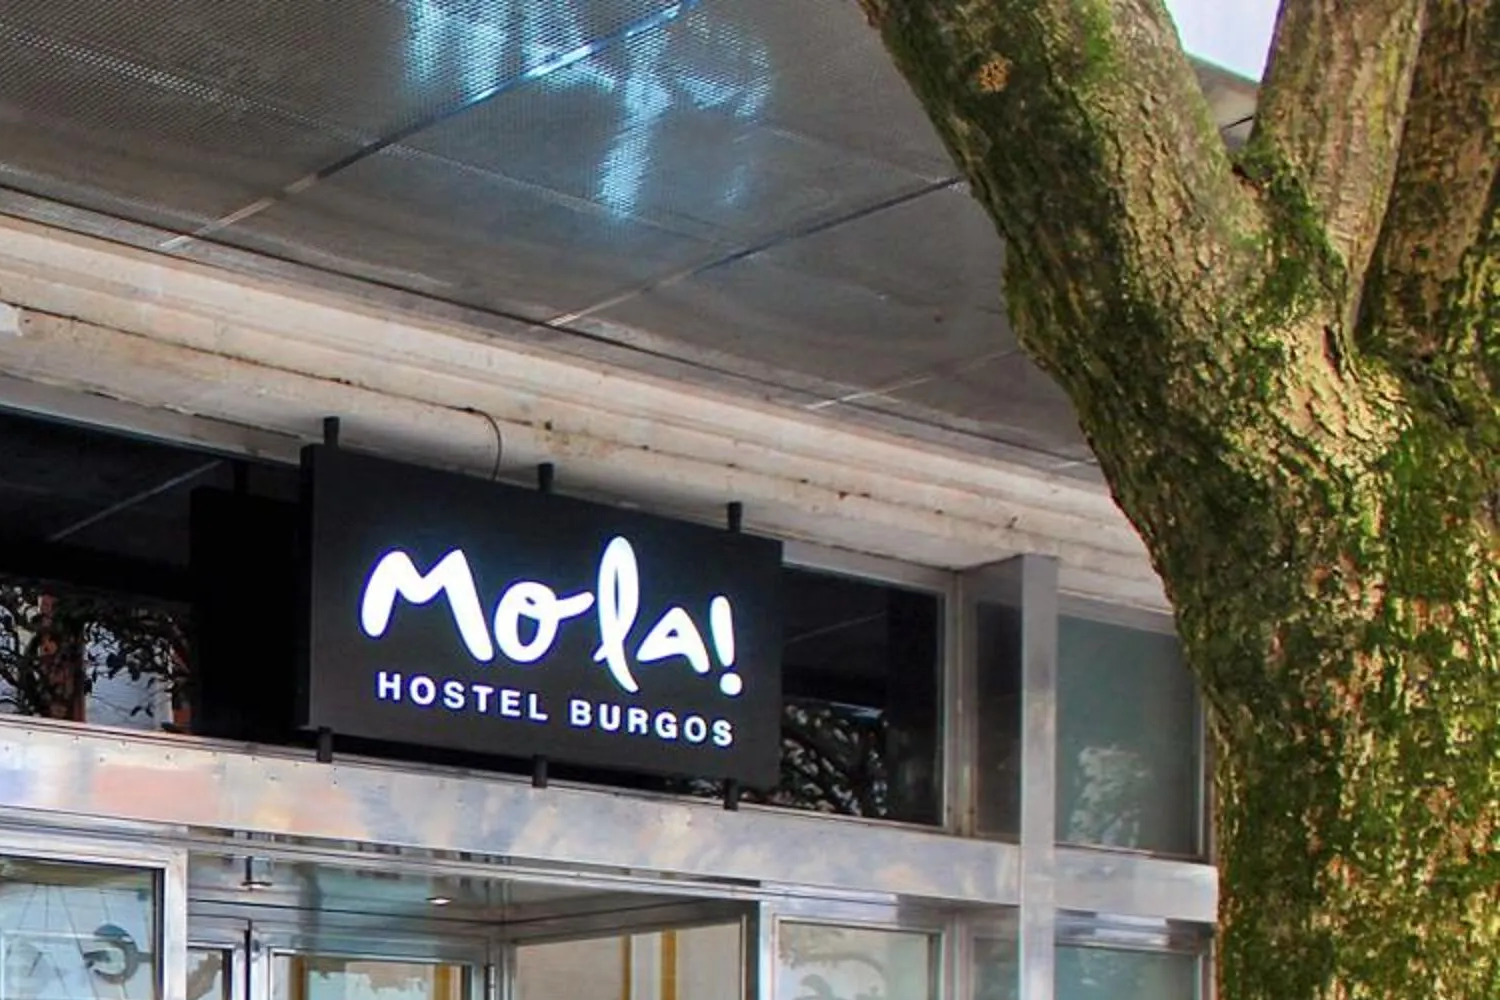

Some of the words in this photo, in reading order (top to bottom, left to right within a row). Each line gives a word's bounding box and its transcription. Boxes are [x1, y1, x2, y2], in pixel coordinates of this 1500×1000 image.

[361, 535, 742, 693] Mola!
[377, 671, 549, 721] HOSTEL
[570, 700, 734, 747] BURGOS
